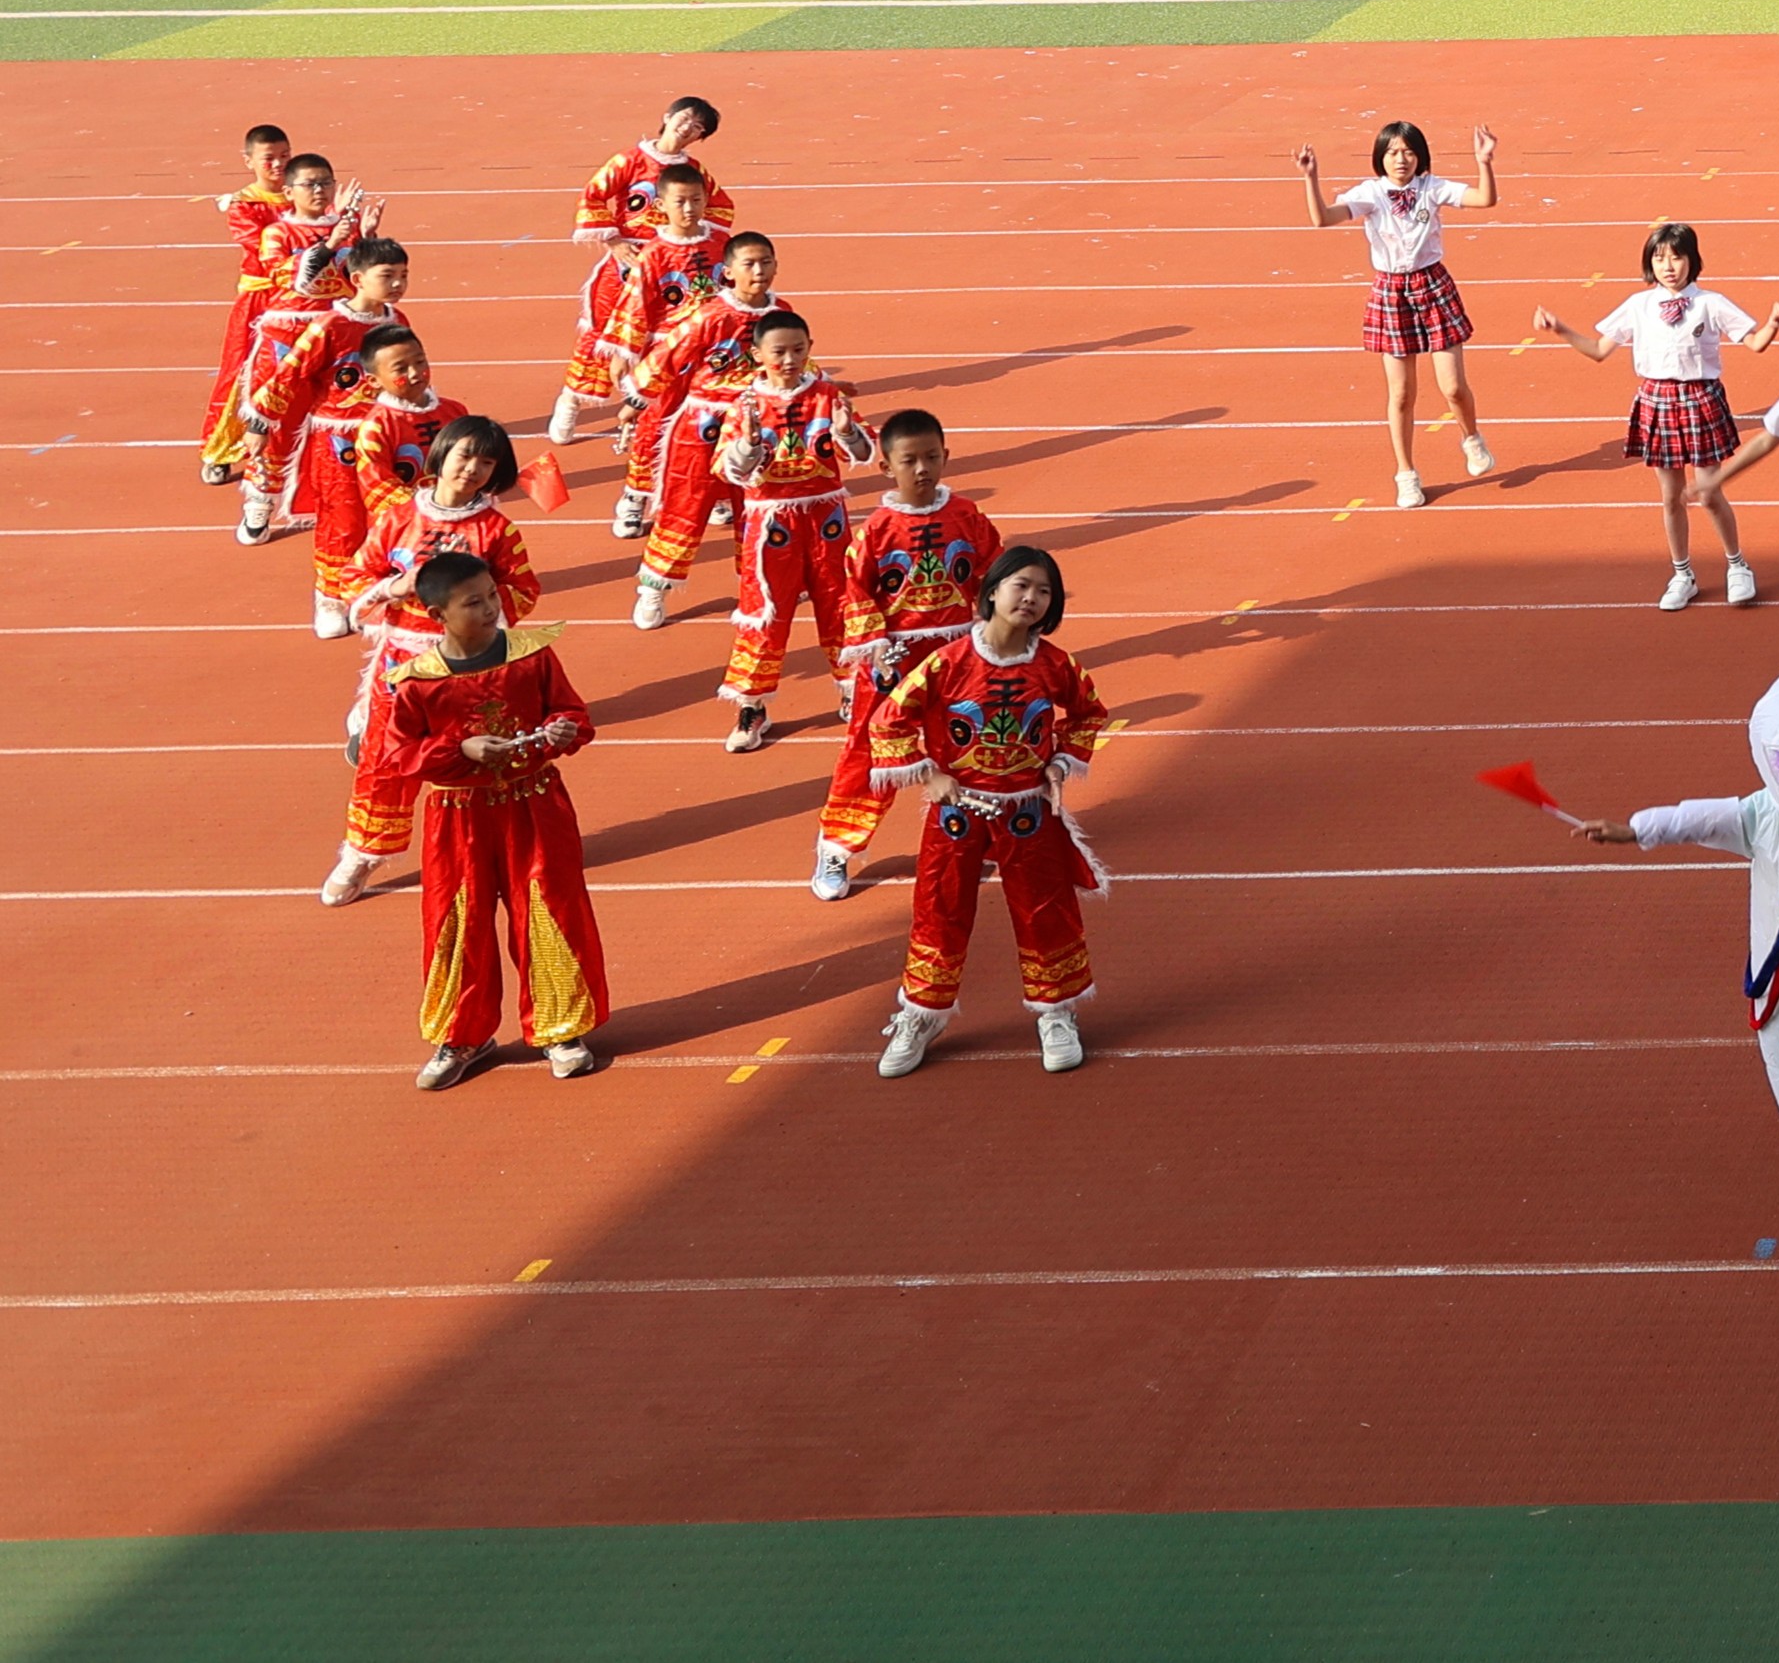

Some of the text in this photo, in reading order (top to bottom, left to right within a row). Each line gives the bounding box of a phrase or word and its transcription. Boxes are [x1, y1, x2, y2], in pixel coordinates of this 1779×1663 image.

[774, 402, 806, 429] 王
[907, 522, 945, 552] 王
[982, 677, 1027, 708] 王
